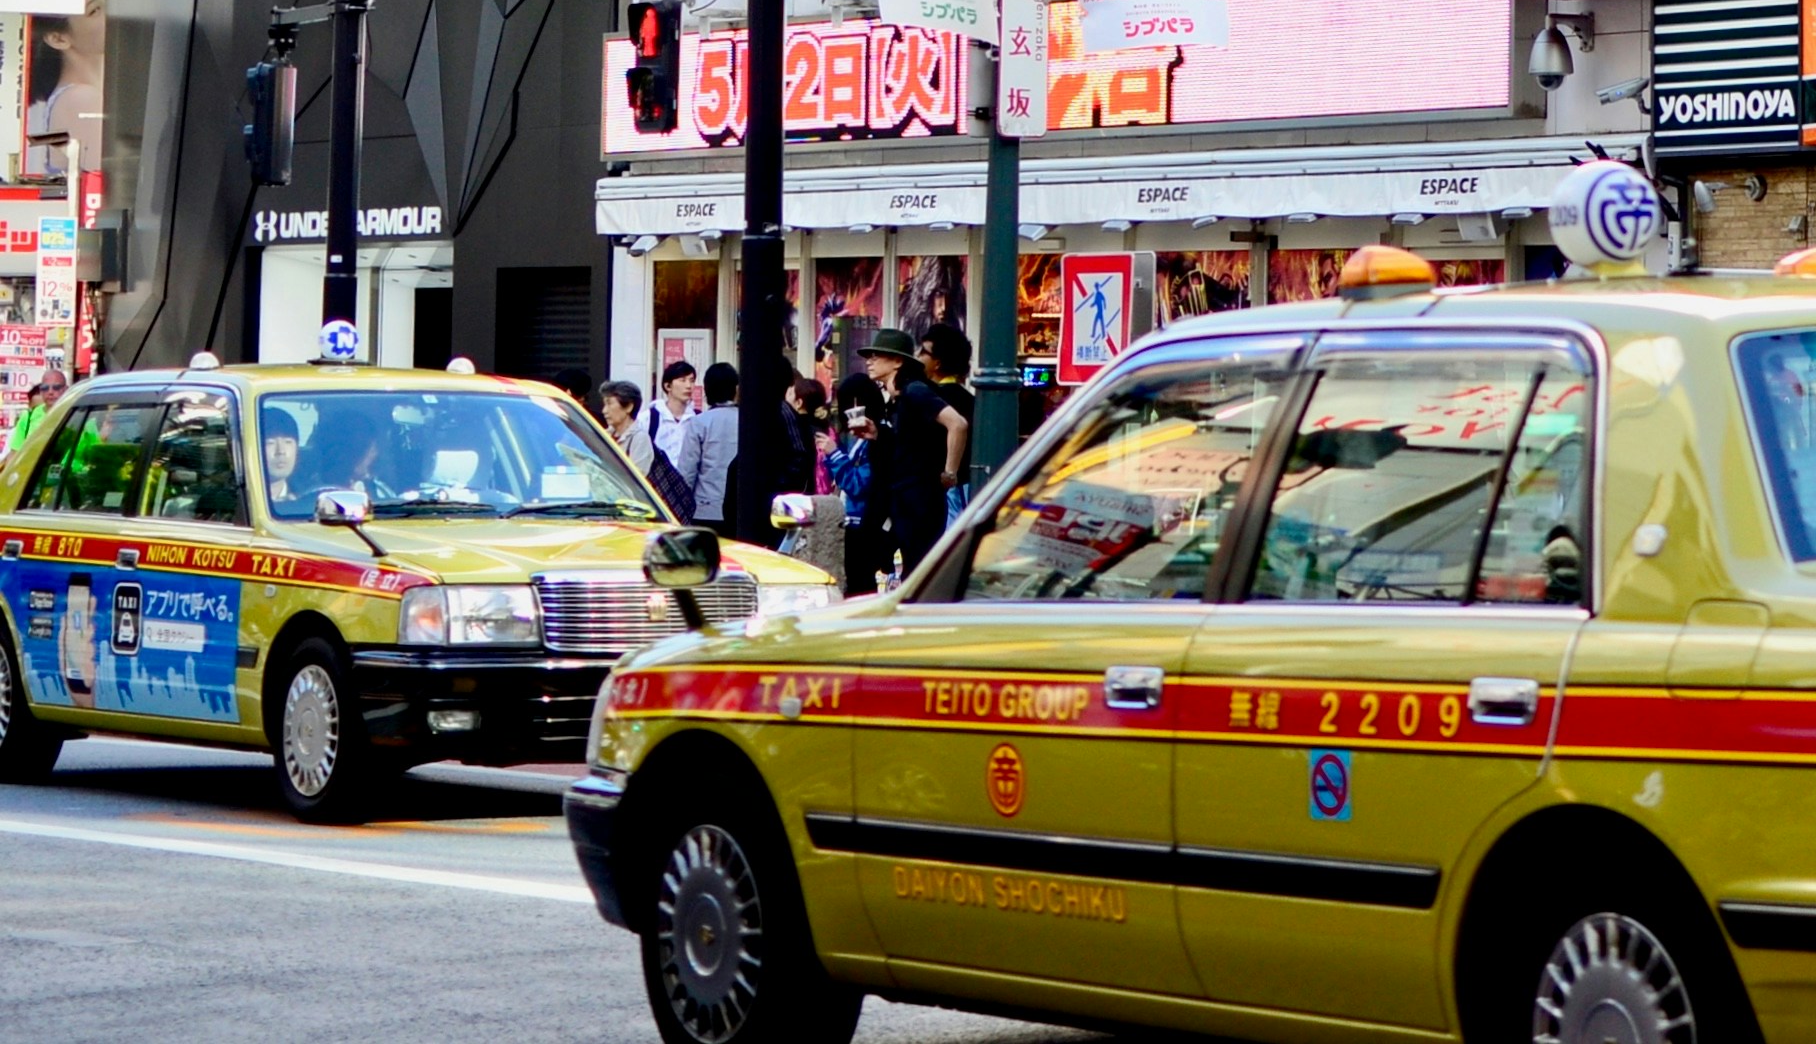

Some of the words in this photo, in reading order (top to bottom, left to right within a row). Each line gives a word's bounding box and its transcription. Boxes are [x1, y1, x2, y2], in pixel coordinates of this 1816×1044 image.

[919, 1, 978, 25] シブパラ
[1123, 17, 1195, 38] シブパラ
[1658, 88, 1795, 125] YOSHINOYA
[1137, 186, 1190, 204] ESPACE
[1419, 177, 1479, 195] ESPACE
[676, 202, 716, 218] ESPACE
[889, 194, 938, 210] ESPACE
[279, 211, 328, 238] UNDE
[57, 537, 82, 556] 870
[146, 545, 186, 564] NIHON
[192, 549, 236, 568] KOTSU
[252, 555, 296, 577] TAXI
[118, 596, 137, 608] TAXI
[759, 676, 840, 708] TAXI
[923, 682, 991, 715] TEITO
[999, 686, 1090, 720] GROUP
[1320, 692, 1461, 738] 2209
[895, 866, 985, 908] DAIYON
[993, 876, 1128, 923] SHOCHIKU
